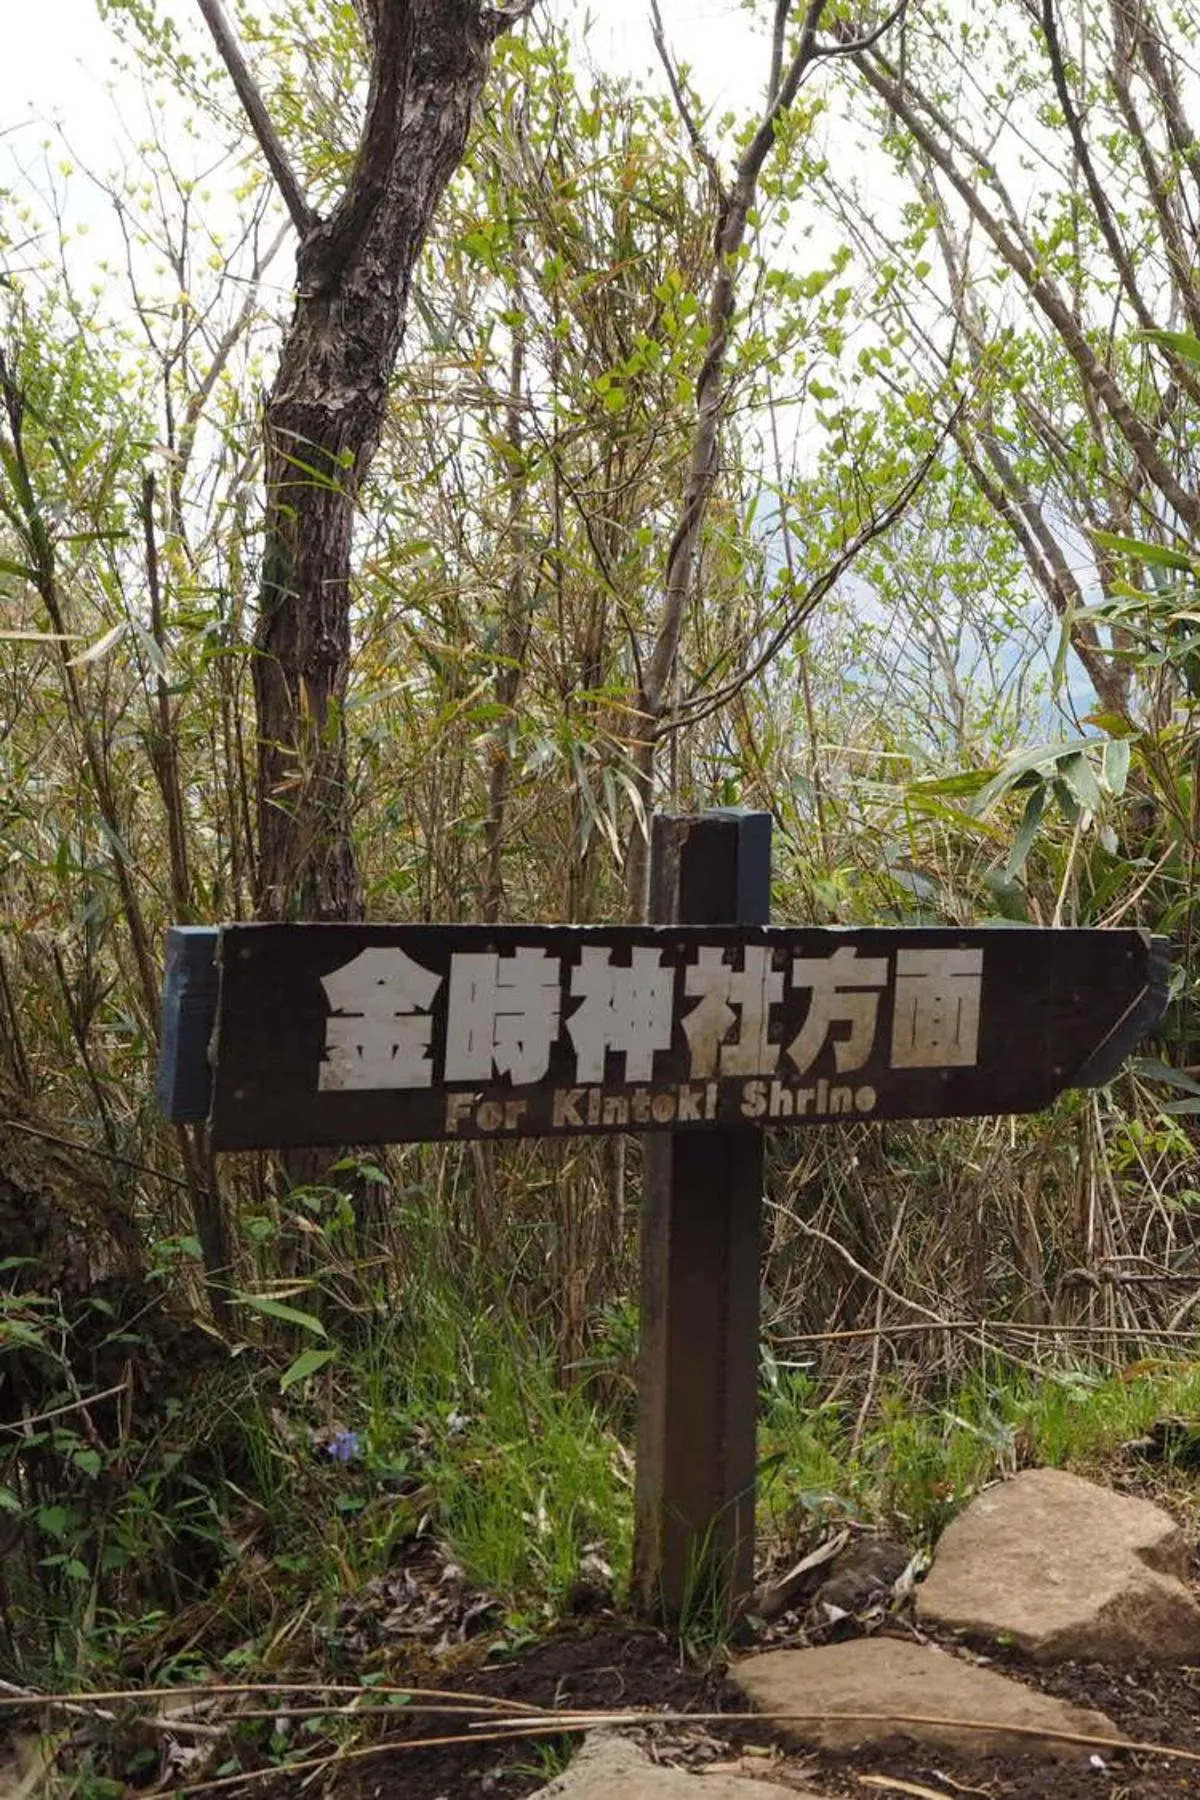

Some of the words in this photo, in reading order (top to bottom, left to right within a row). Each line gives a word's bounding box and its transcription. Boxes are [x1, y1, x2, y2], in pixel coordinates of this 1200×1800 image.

[318, 945, 984, 1091] 金時神社方面
[445, 1092, 527, 1133] For
[553, 1083, 718, 1127] Kintoki
[740, 1079, 877, 1118] Shrine
